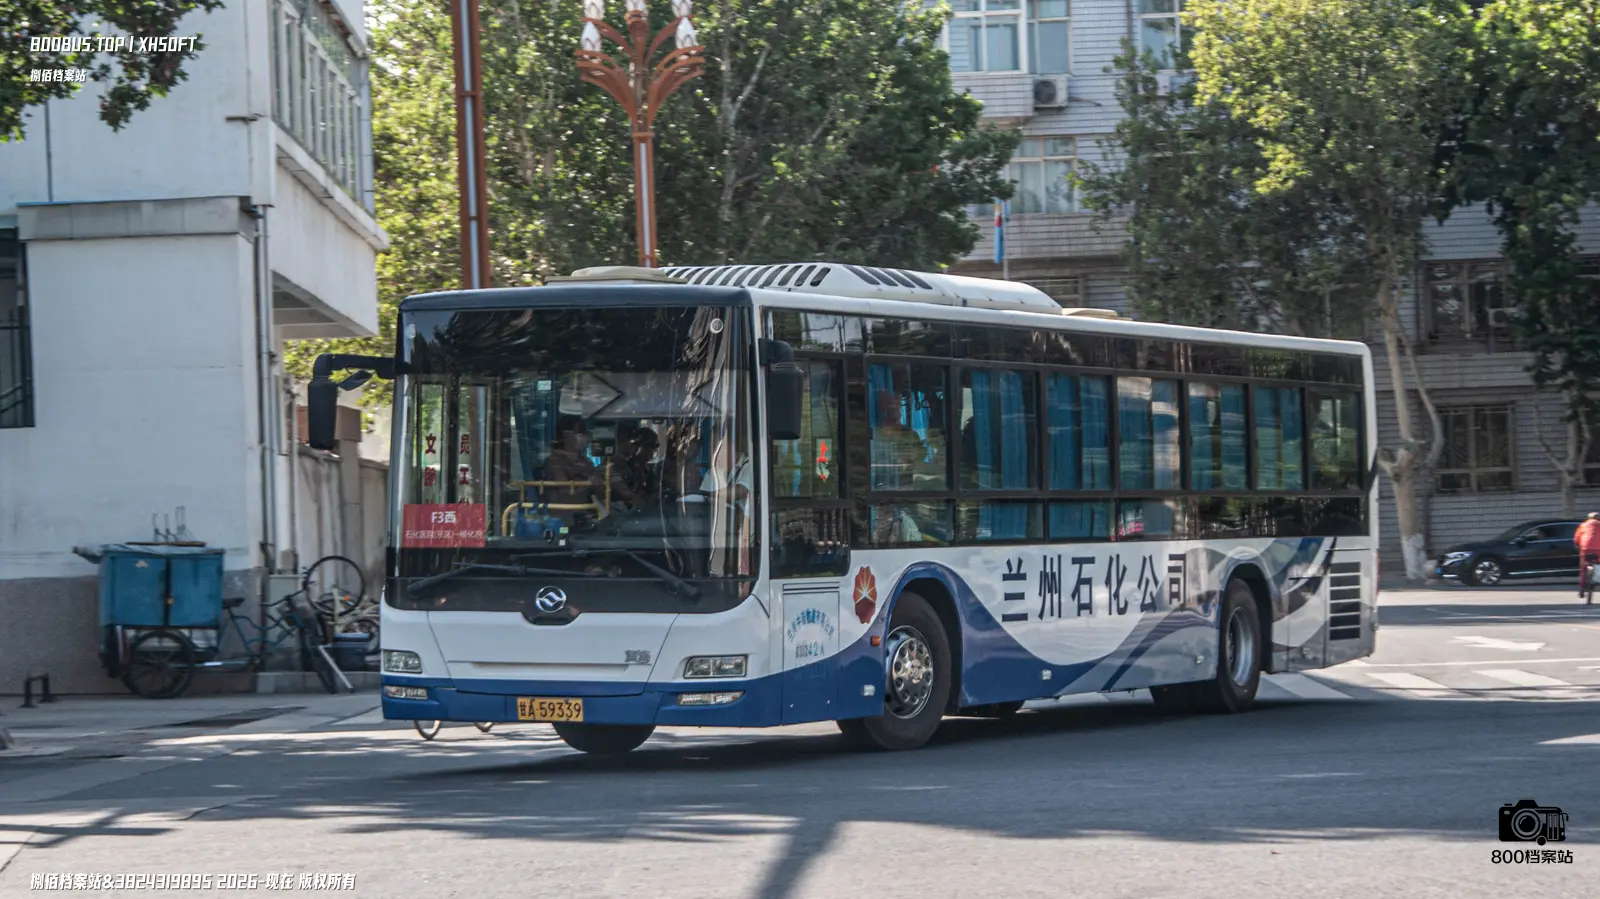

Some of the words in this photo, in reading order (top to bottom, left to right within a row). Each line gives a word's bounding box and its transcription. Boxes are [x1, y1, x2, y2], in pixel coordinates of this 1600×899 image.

[431, 511, 456, 524] F3西
[1001, 553, 1186, 622] 兰州石化公司
